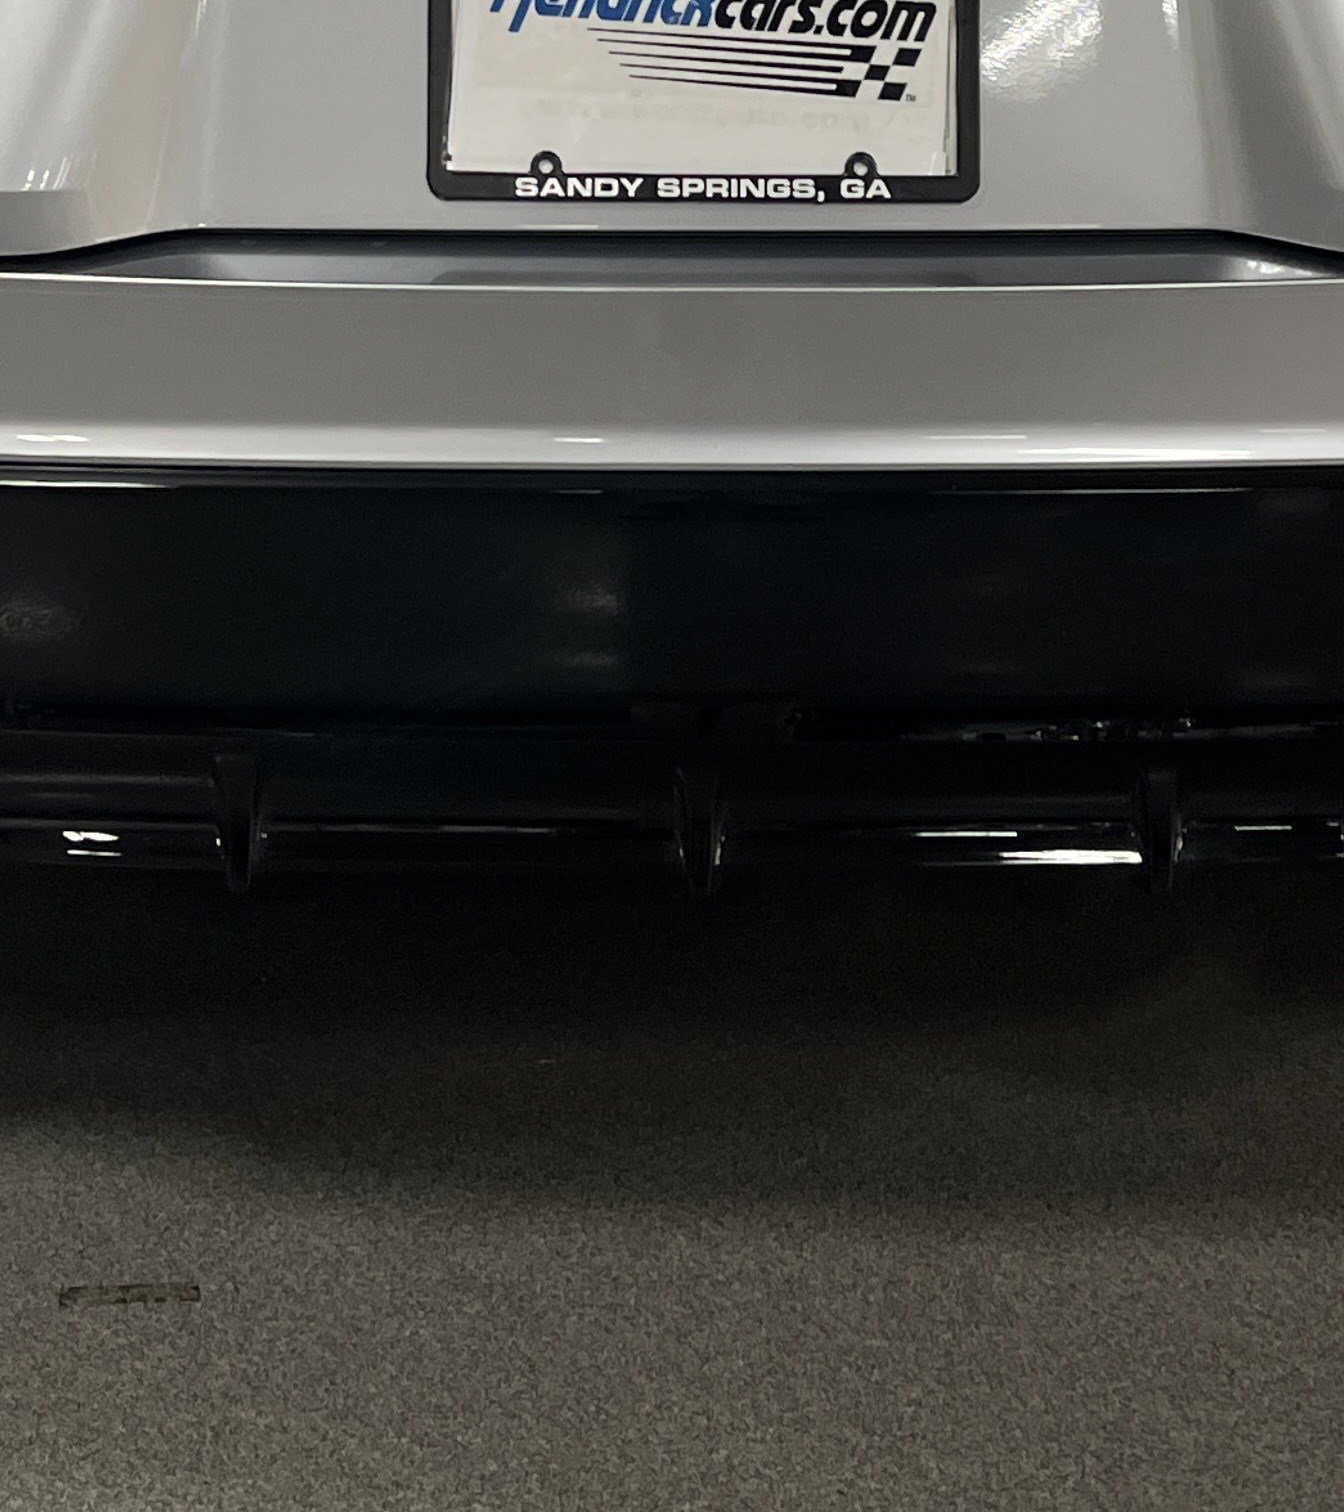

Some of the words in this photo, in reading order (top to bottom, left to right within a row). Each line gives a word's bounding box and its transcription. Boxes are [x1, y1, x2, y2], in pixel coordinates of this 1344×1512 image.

[514, 177, 644, 198] SANDY
[656, 178, 825, 203] SPRINGS,
[840, 179, 891, 200] GA
